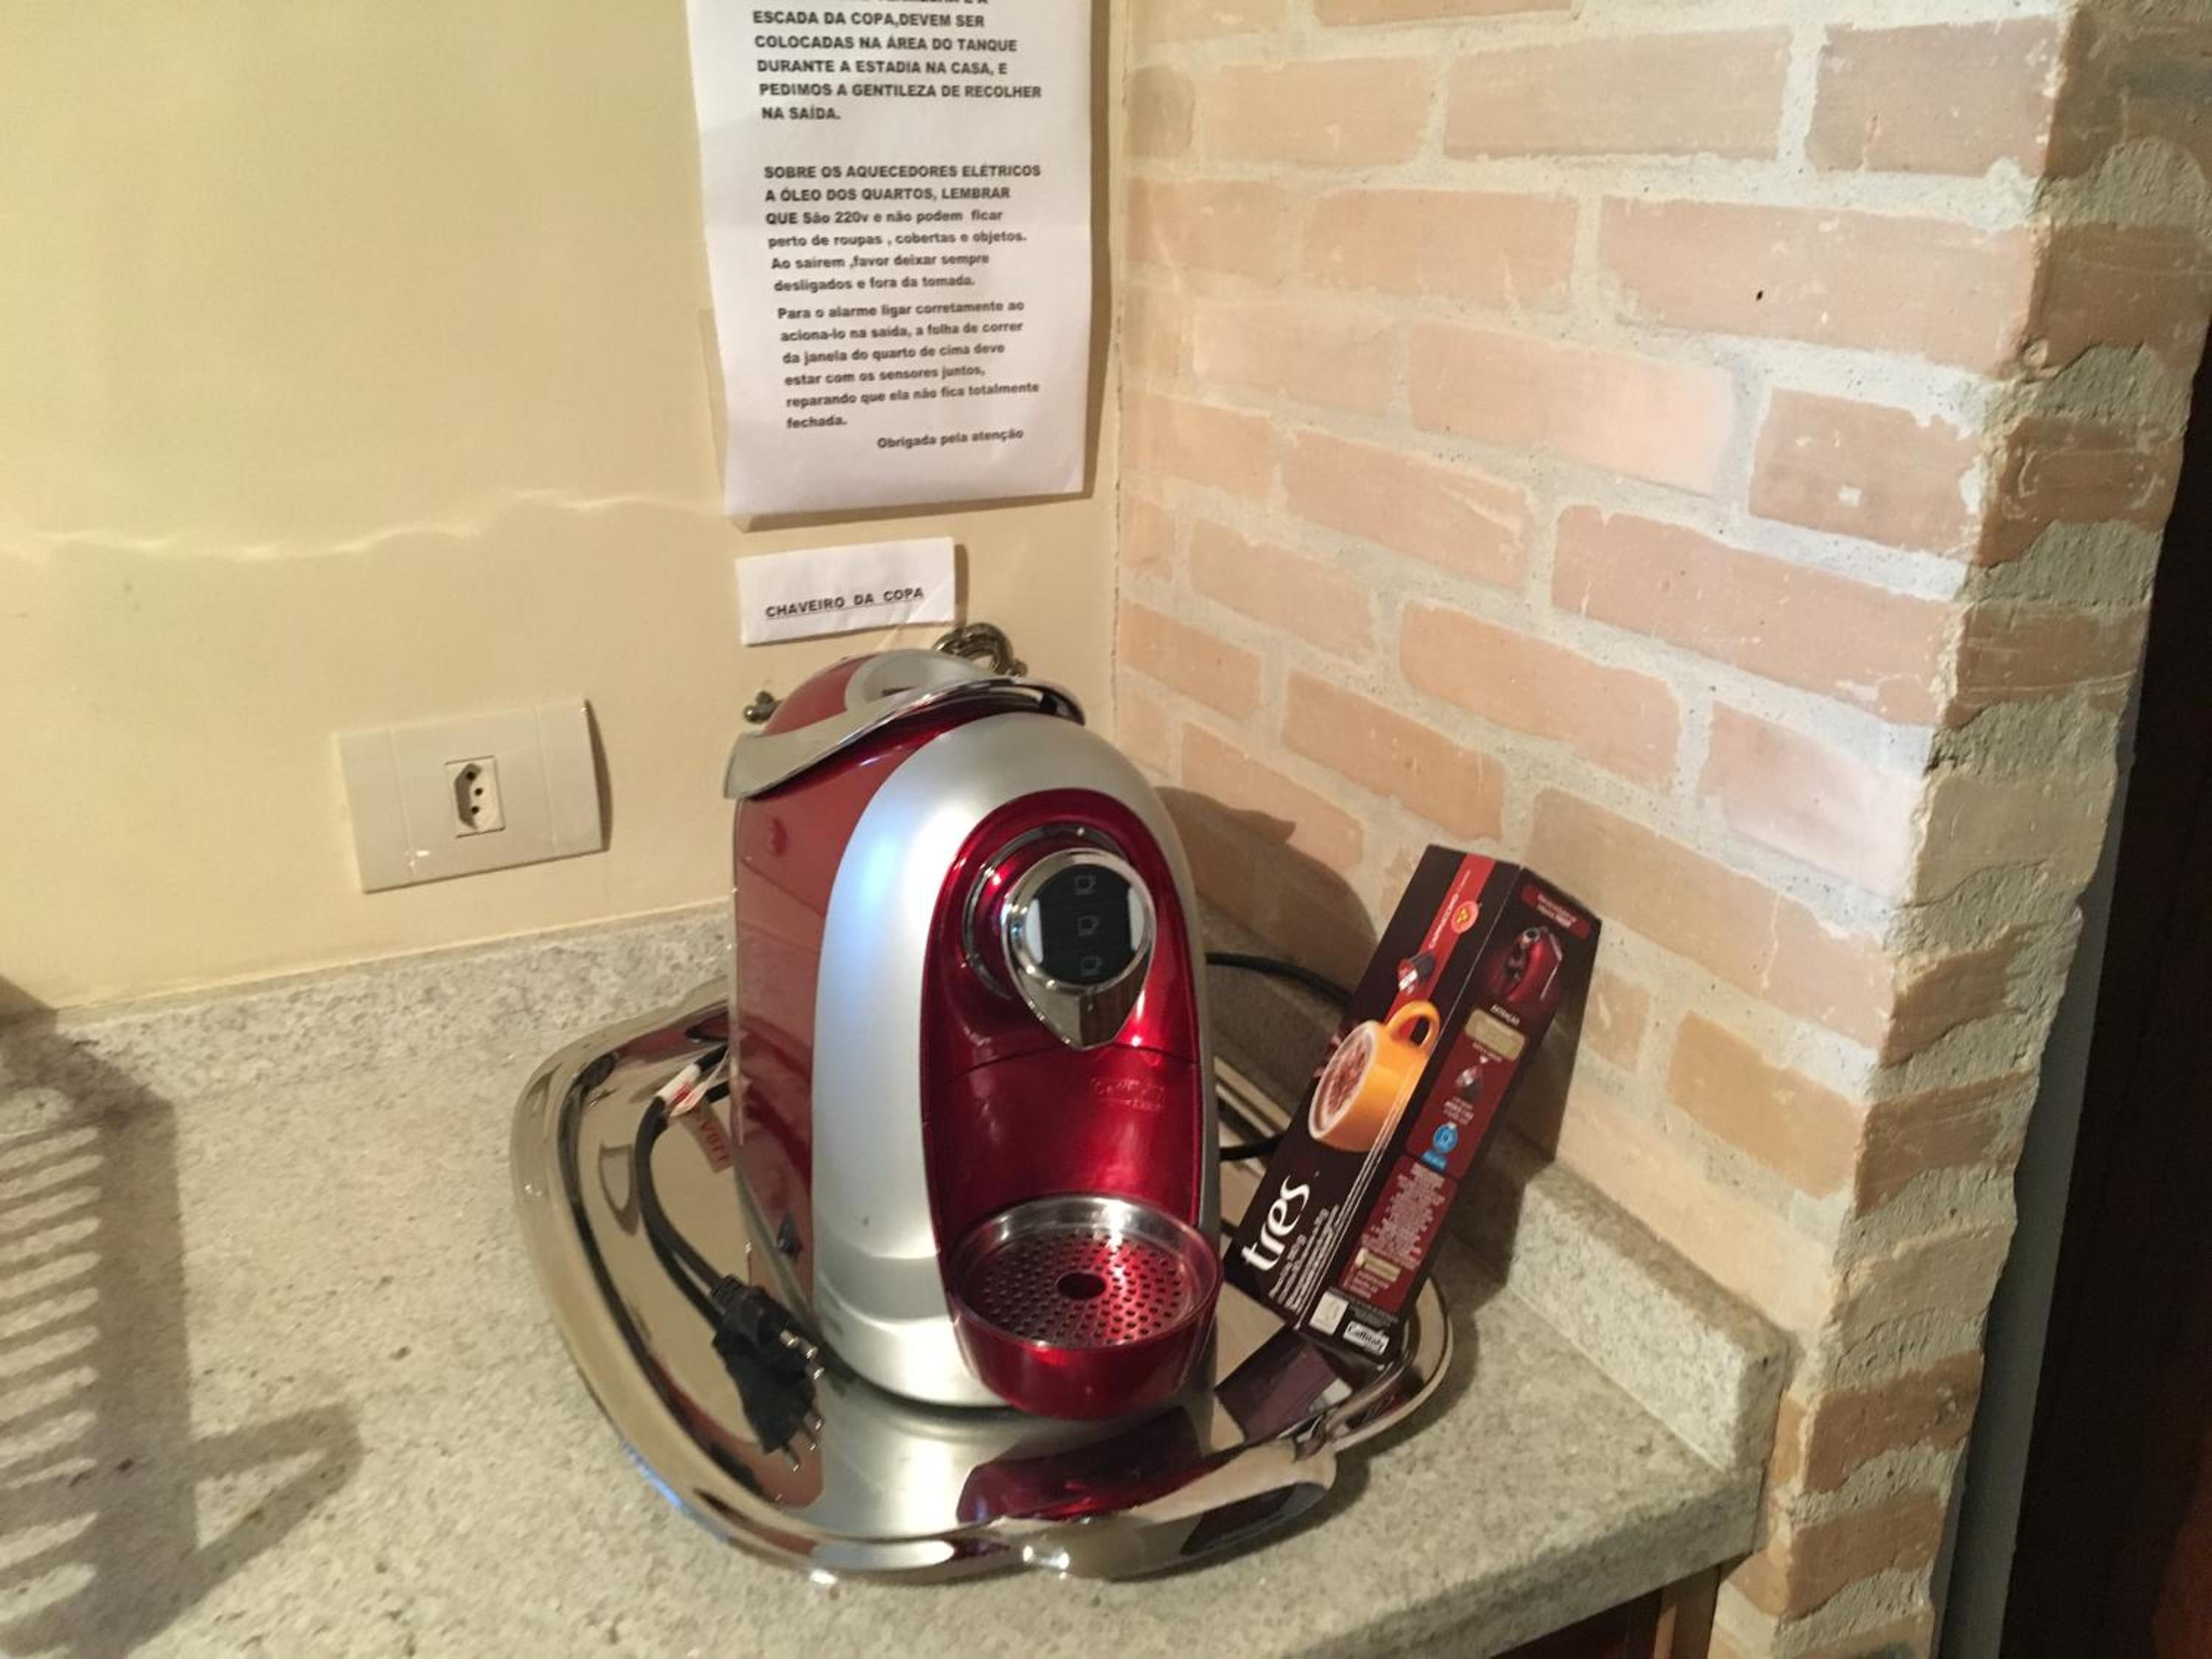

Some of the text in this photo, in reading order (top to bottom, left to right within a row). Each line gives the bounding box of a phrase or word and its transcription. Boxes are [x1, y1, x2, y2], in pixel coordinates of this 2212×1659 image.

[752, 10, 819, 24] ESCADA
[824, 12, 846, 24] DA
[956, 15, 984, 27] SER
[754, 34, 1018, 52] COLOCADAS NA ÁREA DO TANQUE
[757, 59, 1007, 76] DURANTE A ESTADIA NA CASA, E
[759, 83, 1042, 98] PEDIMOS A GENTILEZA DE RECOLHER
[762, 105, 841, 120] NA SAÍDA.
[764, 162, 1041, 179] SOBRE OS AQUECEDORES ELÉTRICOS
[765, 187, 1010, 202] A ÓLEO DOS QUARTOS, LEMBRAR
[765, 212, 799, 225] QUE
[835, 211, 869, 223] 220v
[873, 214, 882, 223] e
[886, 211, 912, 222] não
[917, 210, 963, 224] podem
[971, 209, 1003, 220] ficar
[768, 236, 807, 249] perto
[811, 234, 830, 246] de
[833, 236, 883, 247] roupas
[895, 233, 956, 244] cobertas
[960, 234, 968, 242] e
[973, 231, 1026, 245] objetos.
[771, 257, 791, 269] Ao
[894, 254, 937, 266] deixar
[941, 255, 990, 266] sempre
[773, 275, 975, 293] desligados e fora da tomada.
[777, 301, 1024, 319] Para o alarme ligar corretamente ao
[849, 330, 867, 338] na
[916, 327, 924, 335] a
[927, 324, 959, 335] folha
[963, 323, 978, 333] de
[982, 322, 1023, 333] correr
[782, 344, 1005, 366] da janela do quarto de cima deve
[784, 366, 985, 386] estar com os sensores juntos,
[786, 383, 1040, 409] reparando que ela não fica totalmente
[787, 415, 847, 428] fechada.
[877, 428, 1023, 449] Obrigada pela atenção
[765, 587, 925, 618] CHAVEIRO DA COPA
